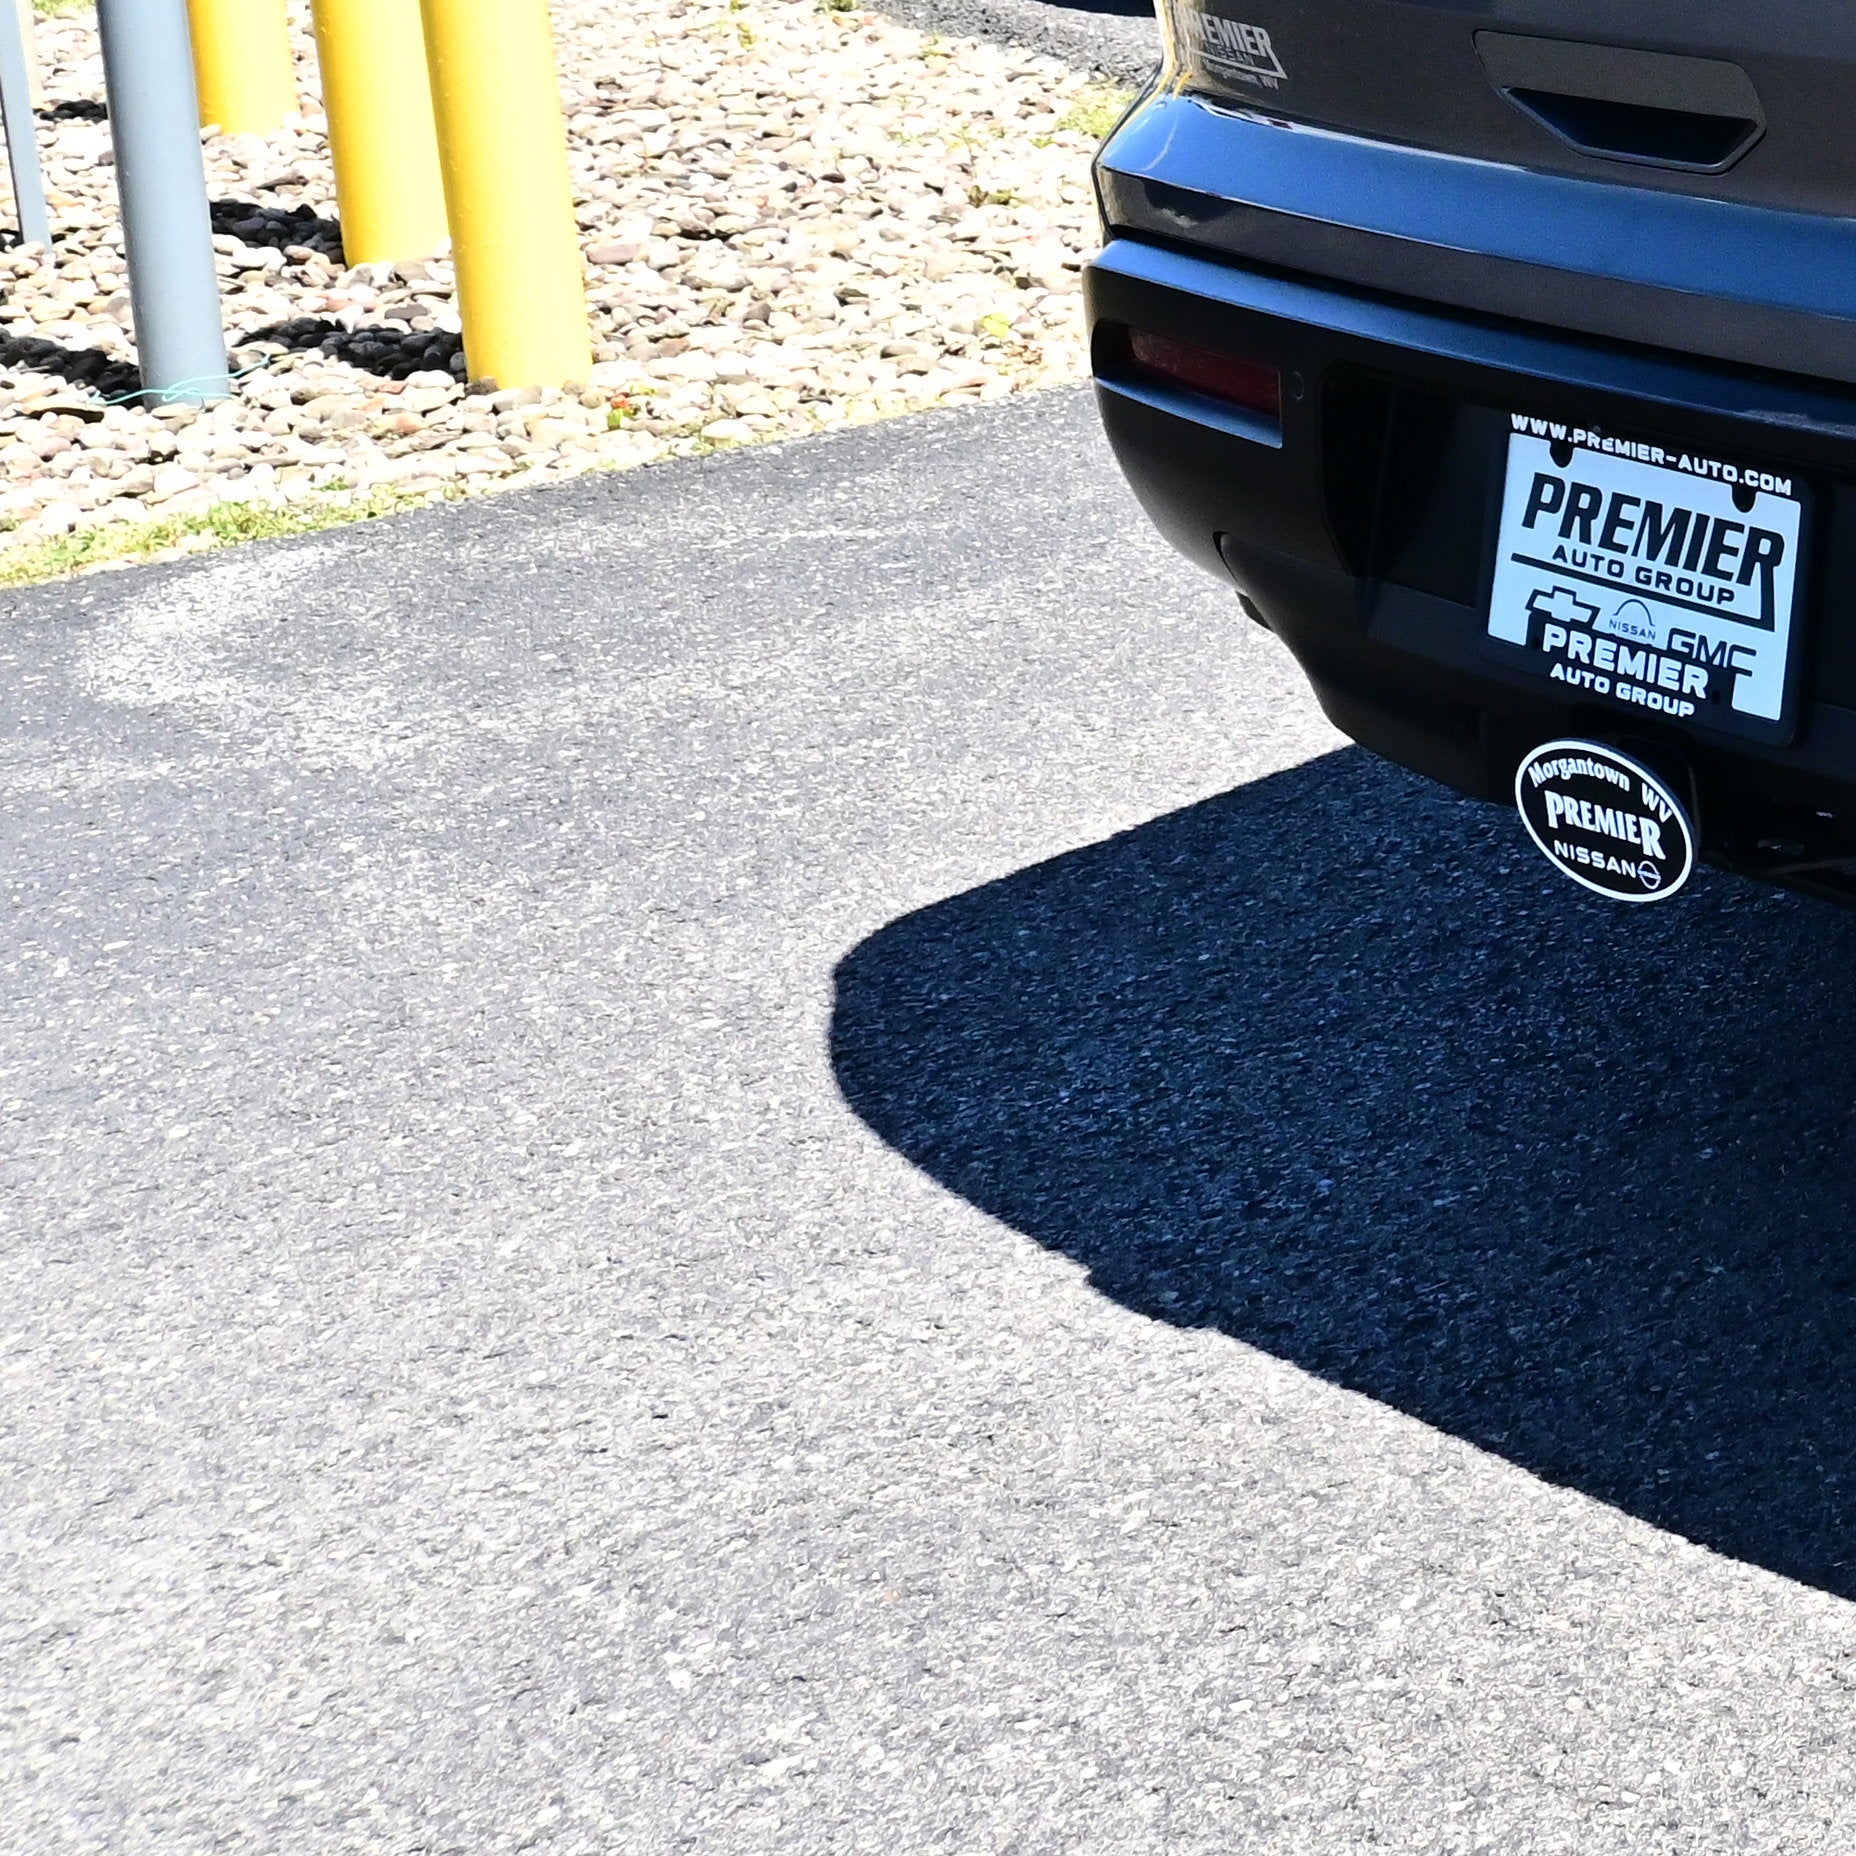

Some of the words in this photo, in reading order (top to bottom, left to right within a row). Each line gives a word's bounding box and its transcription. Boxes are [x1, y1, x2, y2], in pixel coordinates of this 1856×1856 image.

[1510, 412, 1792, 496] WWW.PREMIER-AUTO.COM
[1521, 471, 1786, 631] PREMIER
[1552, 544, 1625, 579] AUTO
[1634, 566, 1736, 606] GROUP
[1542, 622, 1711, 699] PREMIER
[1608, 618, 1657, 641] NISSAN
[1665, 627, 1757, 677] GMC
[1549, 662, 1610, 695] AUTO
[1615, 681, 1696, 719] GROUP
[1527, 756, 1631, 792] Morgantown
[1641, 782, 1673, 824] WV
[1544, 790, 1667, 861] PREMIER
[1554, 839, 1637, 879] NISSAN
